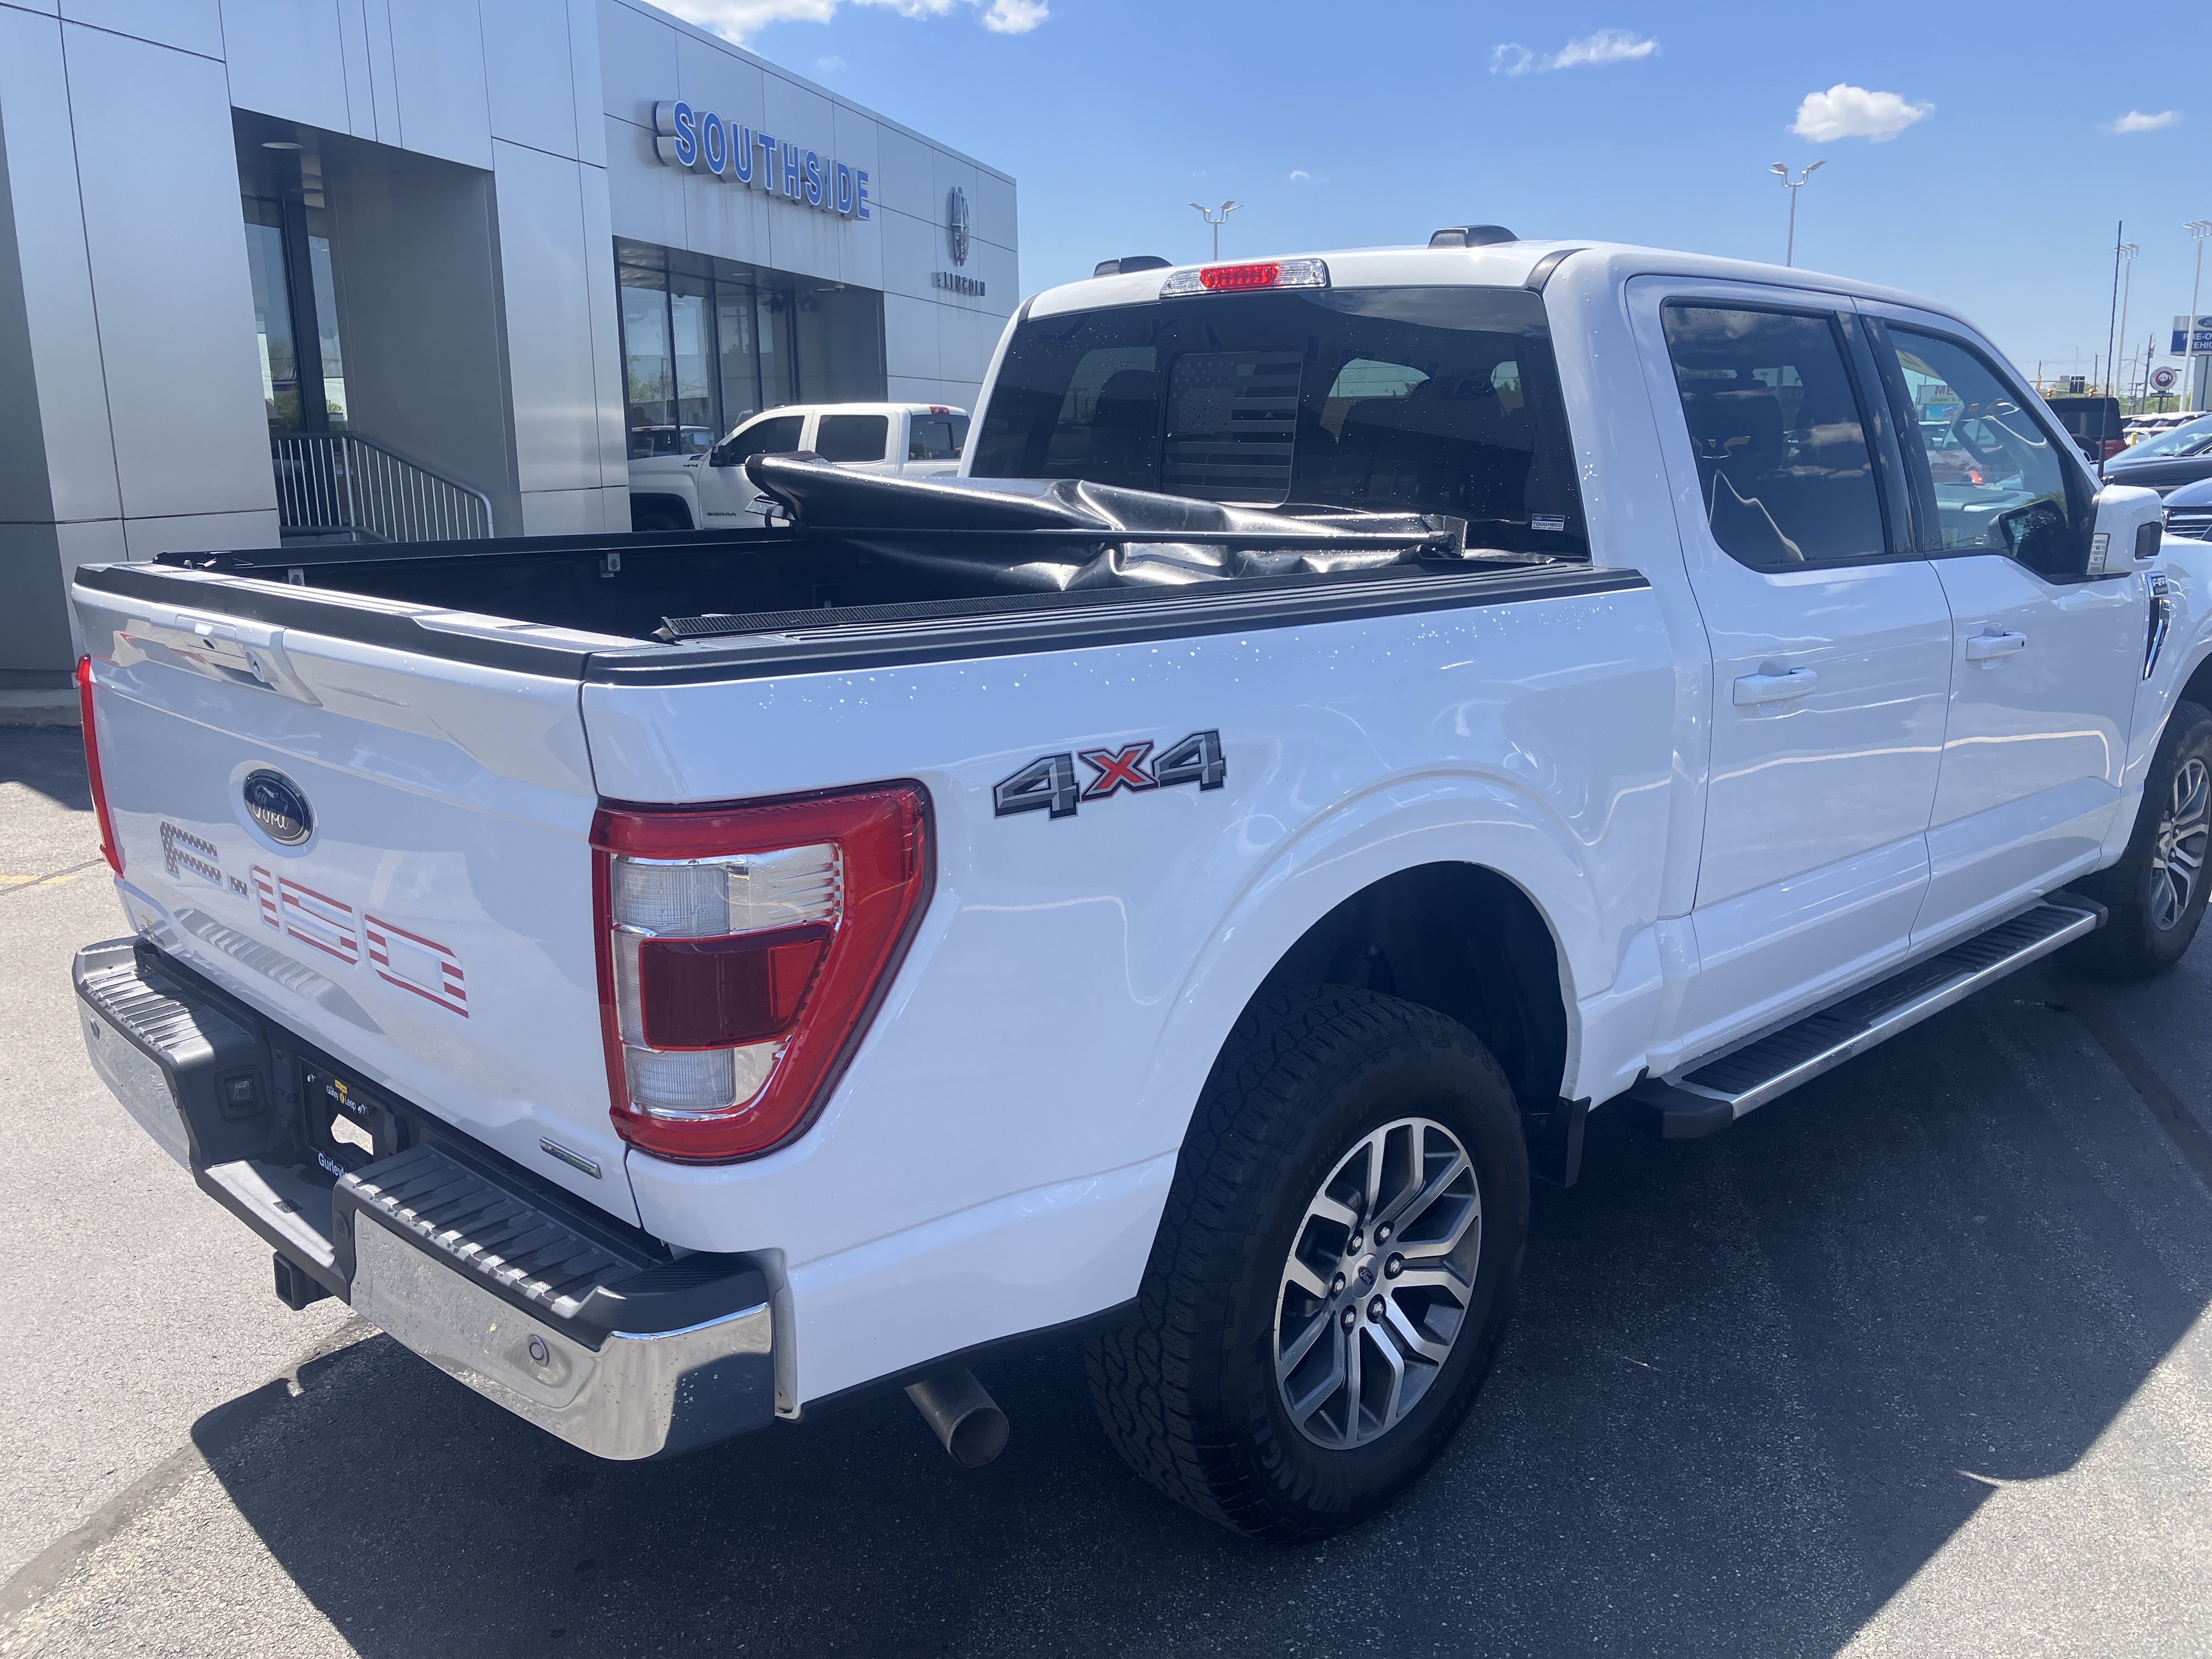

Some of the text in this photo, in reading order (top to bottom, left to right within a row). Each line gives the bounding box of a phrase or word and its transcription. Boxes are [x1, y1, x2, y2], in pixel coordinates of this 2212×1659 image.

[673, 99, 871, 219] SOUTHSIDE
[944, 271, 985, 297] LINCOLN
[252, 783, 290, 831] Ford
[160, 821, 470, 1020] F-150
[344, 1094, 357, 1112] Leep
[1359, 1269, 1373, 1284] Ford
